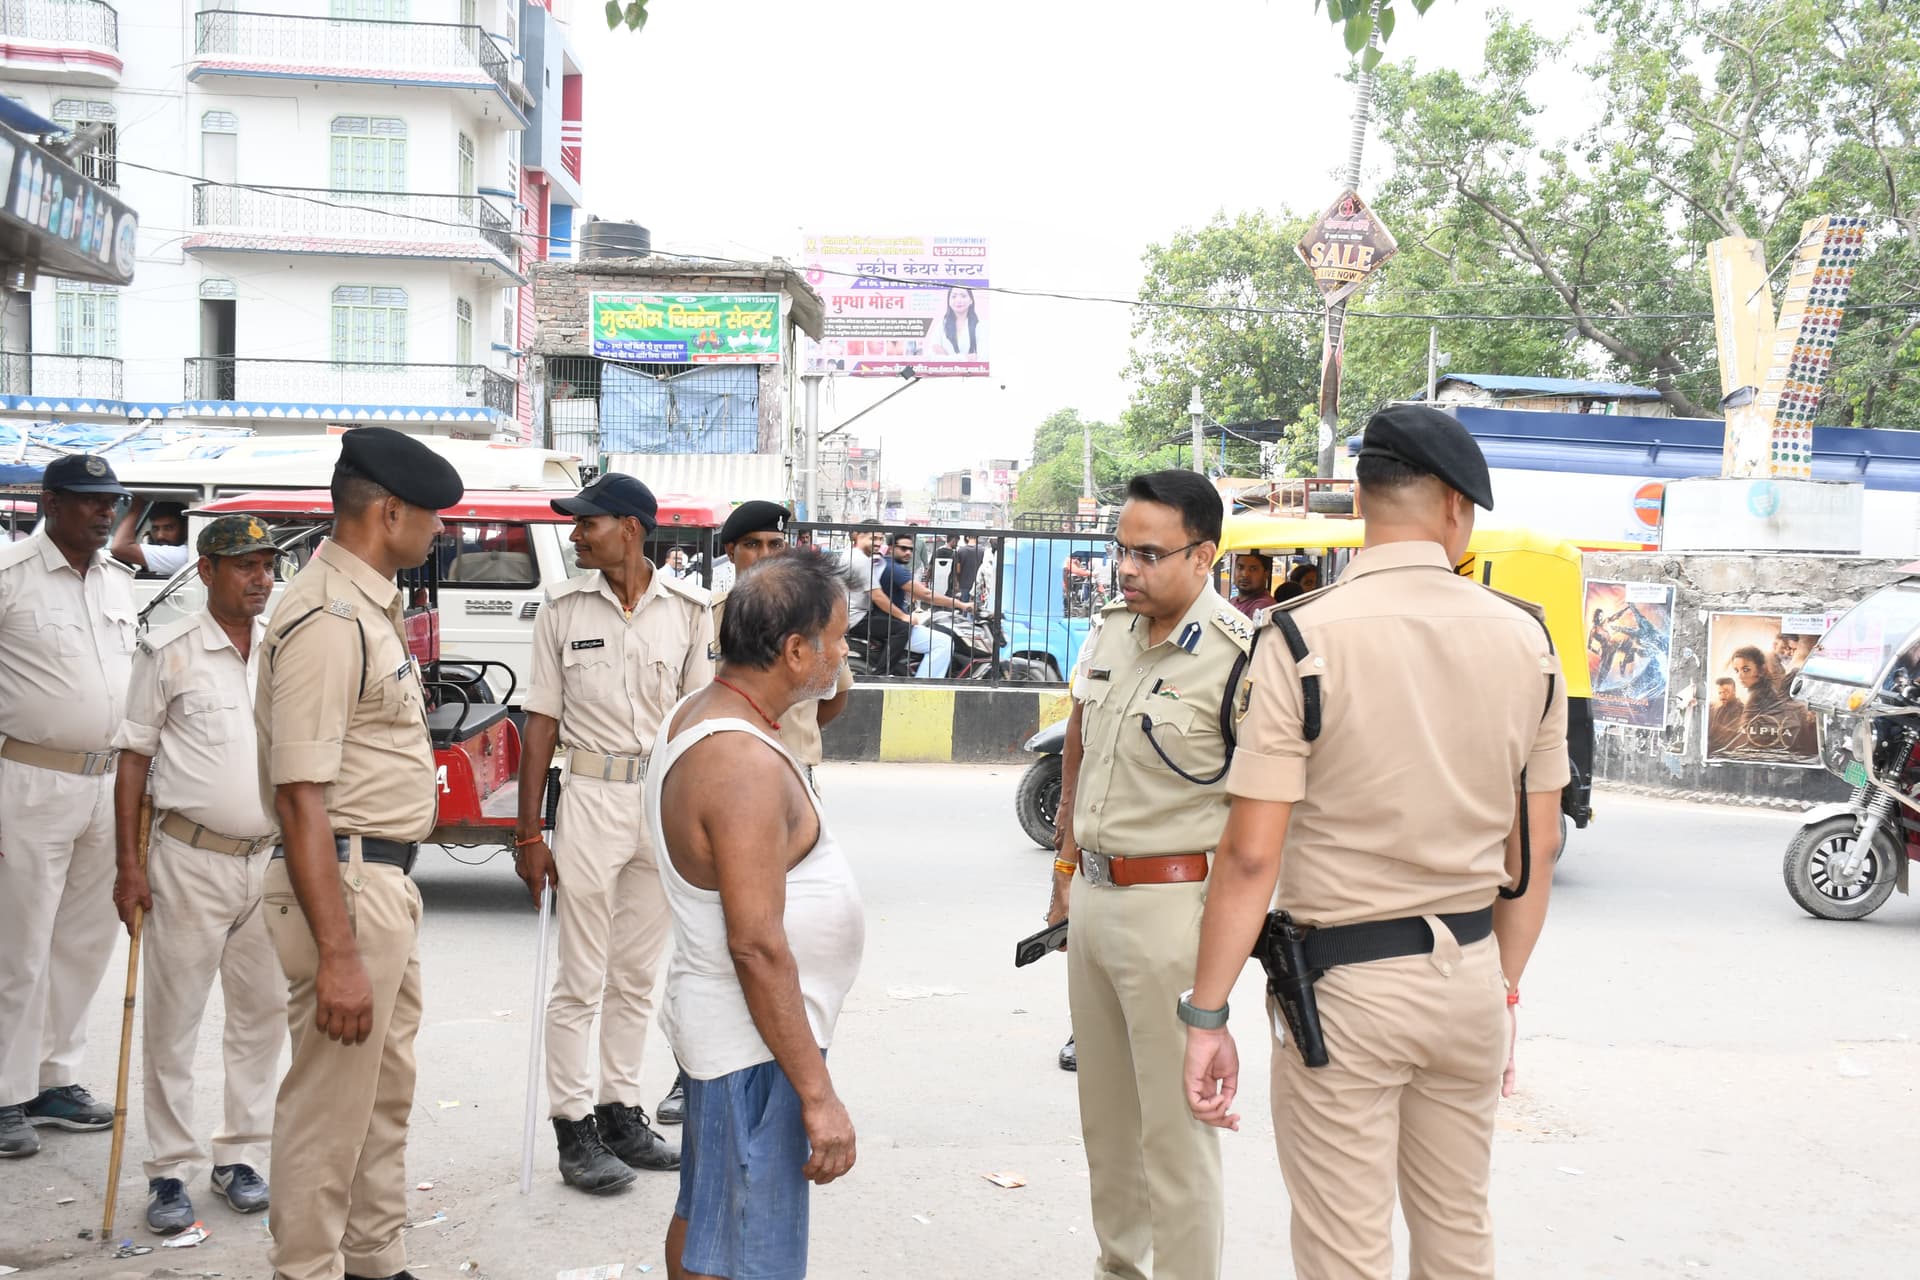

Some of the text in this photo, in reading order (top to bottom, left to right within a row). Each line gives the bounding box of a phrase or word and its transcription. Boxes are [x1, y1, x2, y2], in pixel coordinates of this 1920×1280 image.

[902, 257, 940, 276] केयर
[943, 257, 984, 276] सेन्टर
[1310, 242, 1375, 272] SALE
[1337, 271, 1358, 280] NOW
[831, 295, 864, 314] मुग्धा
[868, 292, 905, 310] मोहन
[724, 304, 773, 329] सेन्टर
[464, 600, 512, 611] BOLERO
[1737, 726, 1793, 737] ALPHA
